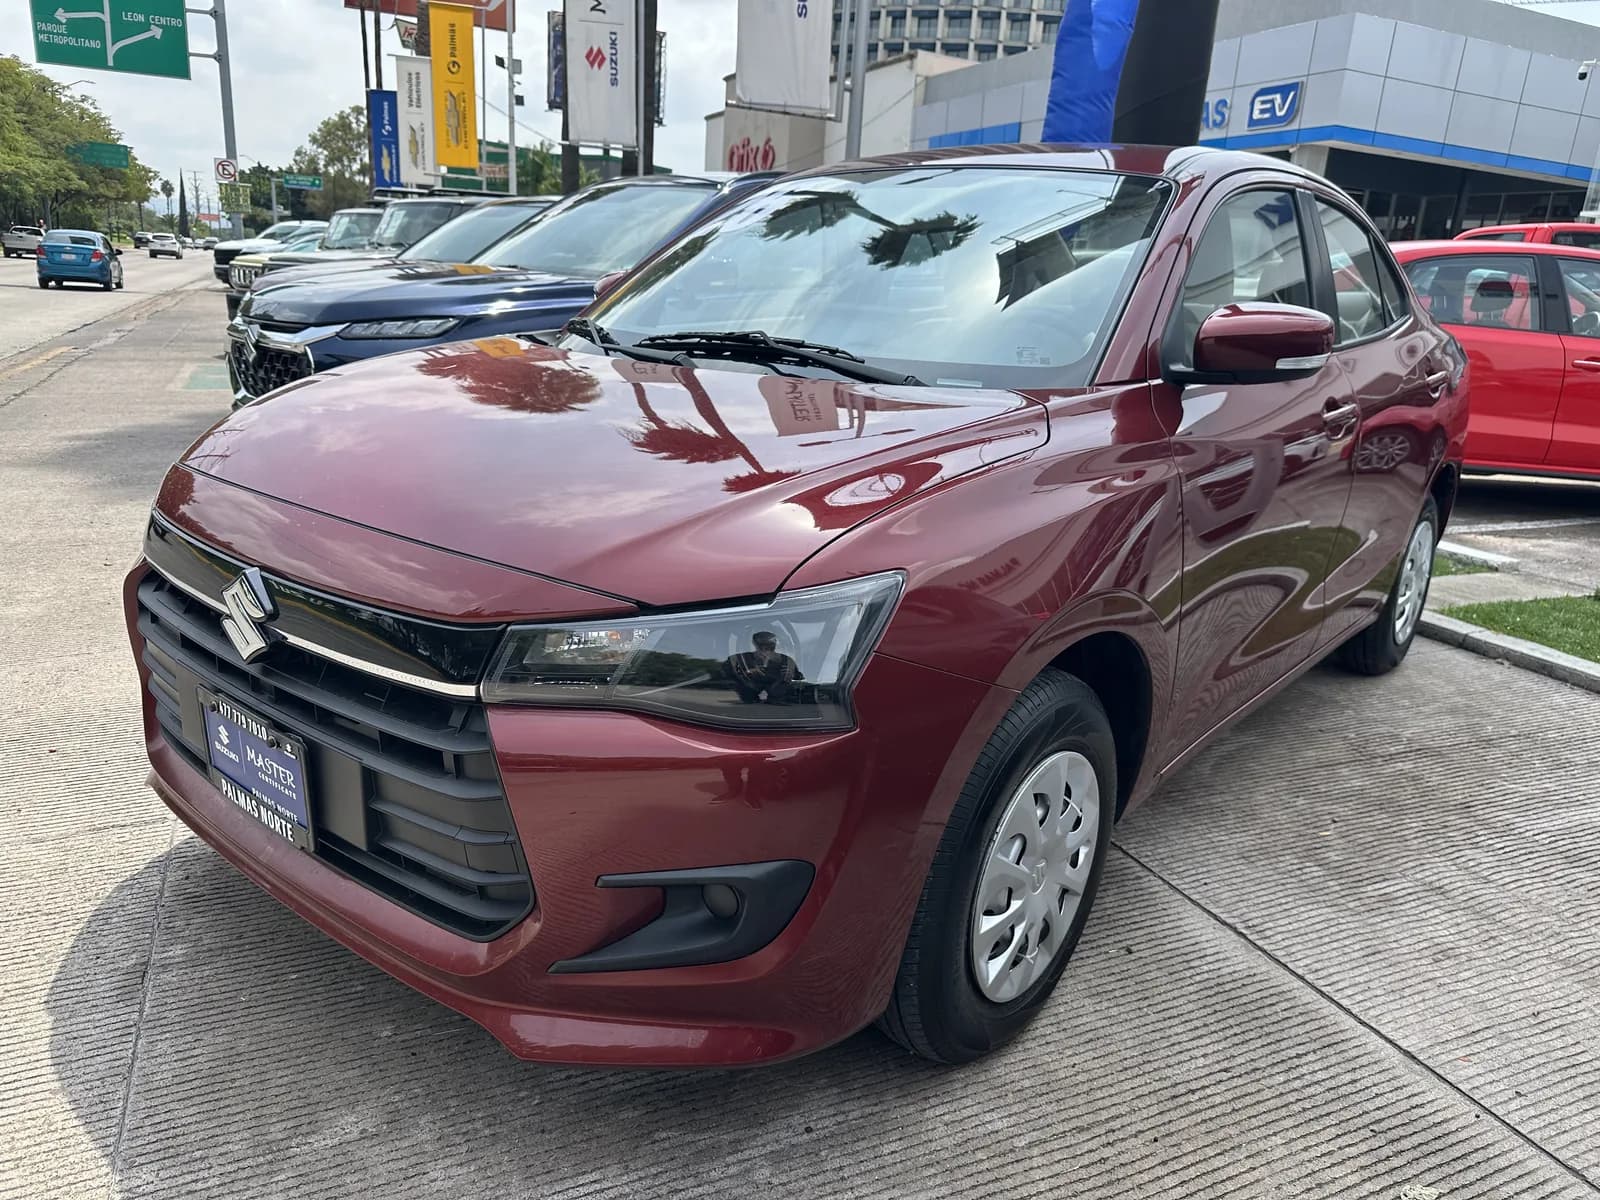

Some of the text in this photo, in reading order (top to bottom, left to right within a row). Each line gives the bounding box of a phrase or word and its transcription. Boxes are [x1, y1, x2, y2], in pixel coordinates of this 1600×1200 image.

[36, 21, 68, 34] PARQUE
[122, 11, 183, 28] LEON CENTRO
[38, 33, 101, 49] METROPOLITANO
[609, 31, 618, 87] SUZUKI
[1252, 91, 1295, 119] EV
[232, 710, 247, 730] 779
[248, 718, 268, 740] 7010
[214, 741, 239, 763] SUZUKI
[246, 745, 296, 788] MASTER
[258, 771, 297, 800] CERTIFICATE
[221, 778, 295, 842] PALMAS NORTE
[252, 788, 298, 823] PALMAS NORTE
